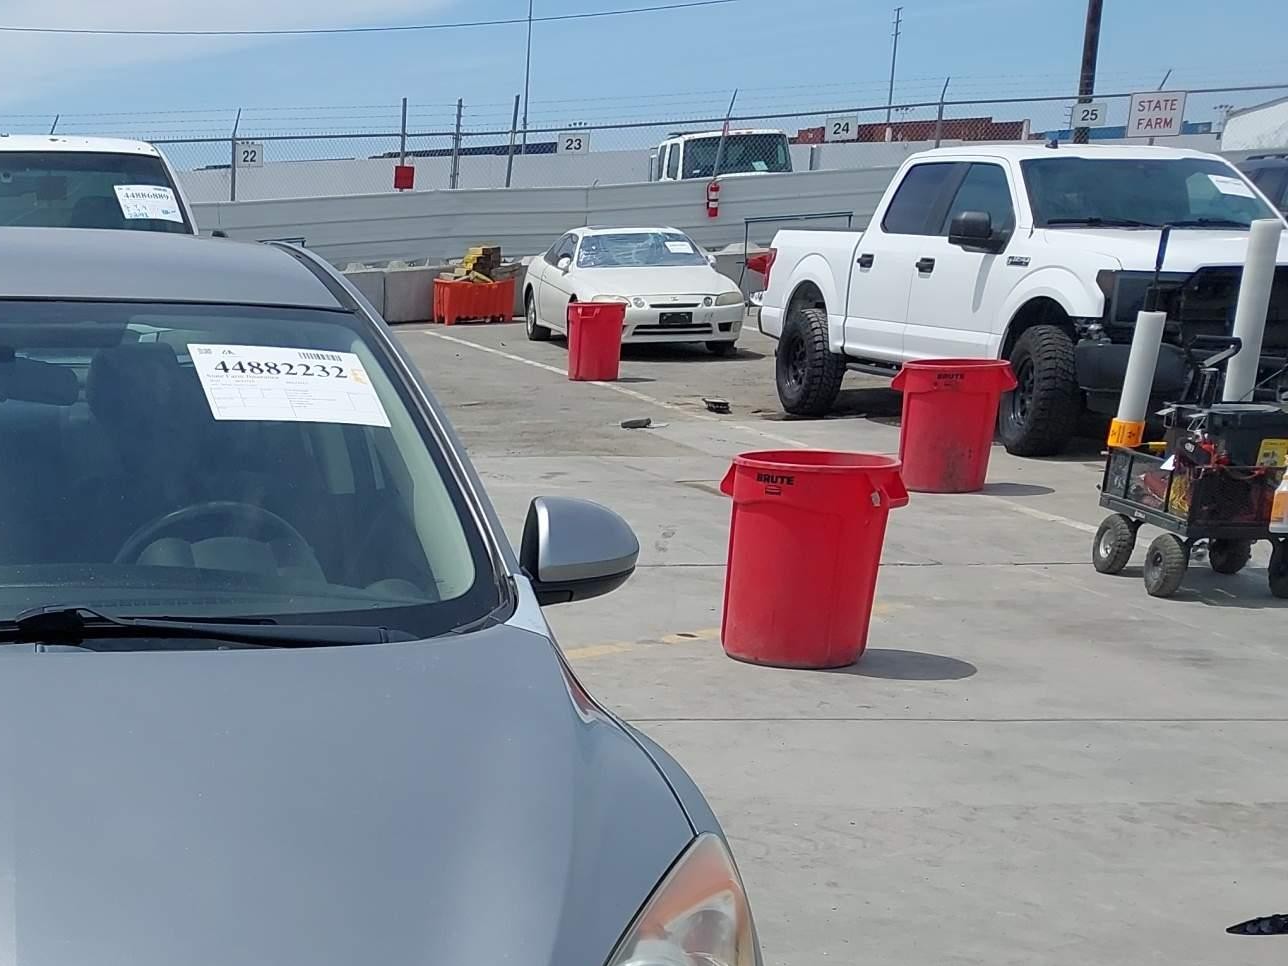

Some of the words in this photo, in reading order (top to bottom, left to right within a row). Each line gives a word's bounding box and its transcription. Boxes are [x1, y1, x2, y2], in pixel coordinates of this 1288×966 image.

[1137, 99, 1178, 113] STATE
[1081, 109, 1098, 121] 25
[833, 122, 849, 135] 24
[1137, 117, 1173, 130] FARM
[565, 138, 582, 150] 23
[242, 150, 257, 163] 22
[214, 360, 348, 379] 44882232
[756, 472, 795, 486] BRUTE
